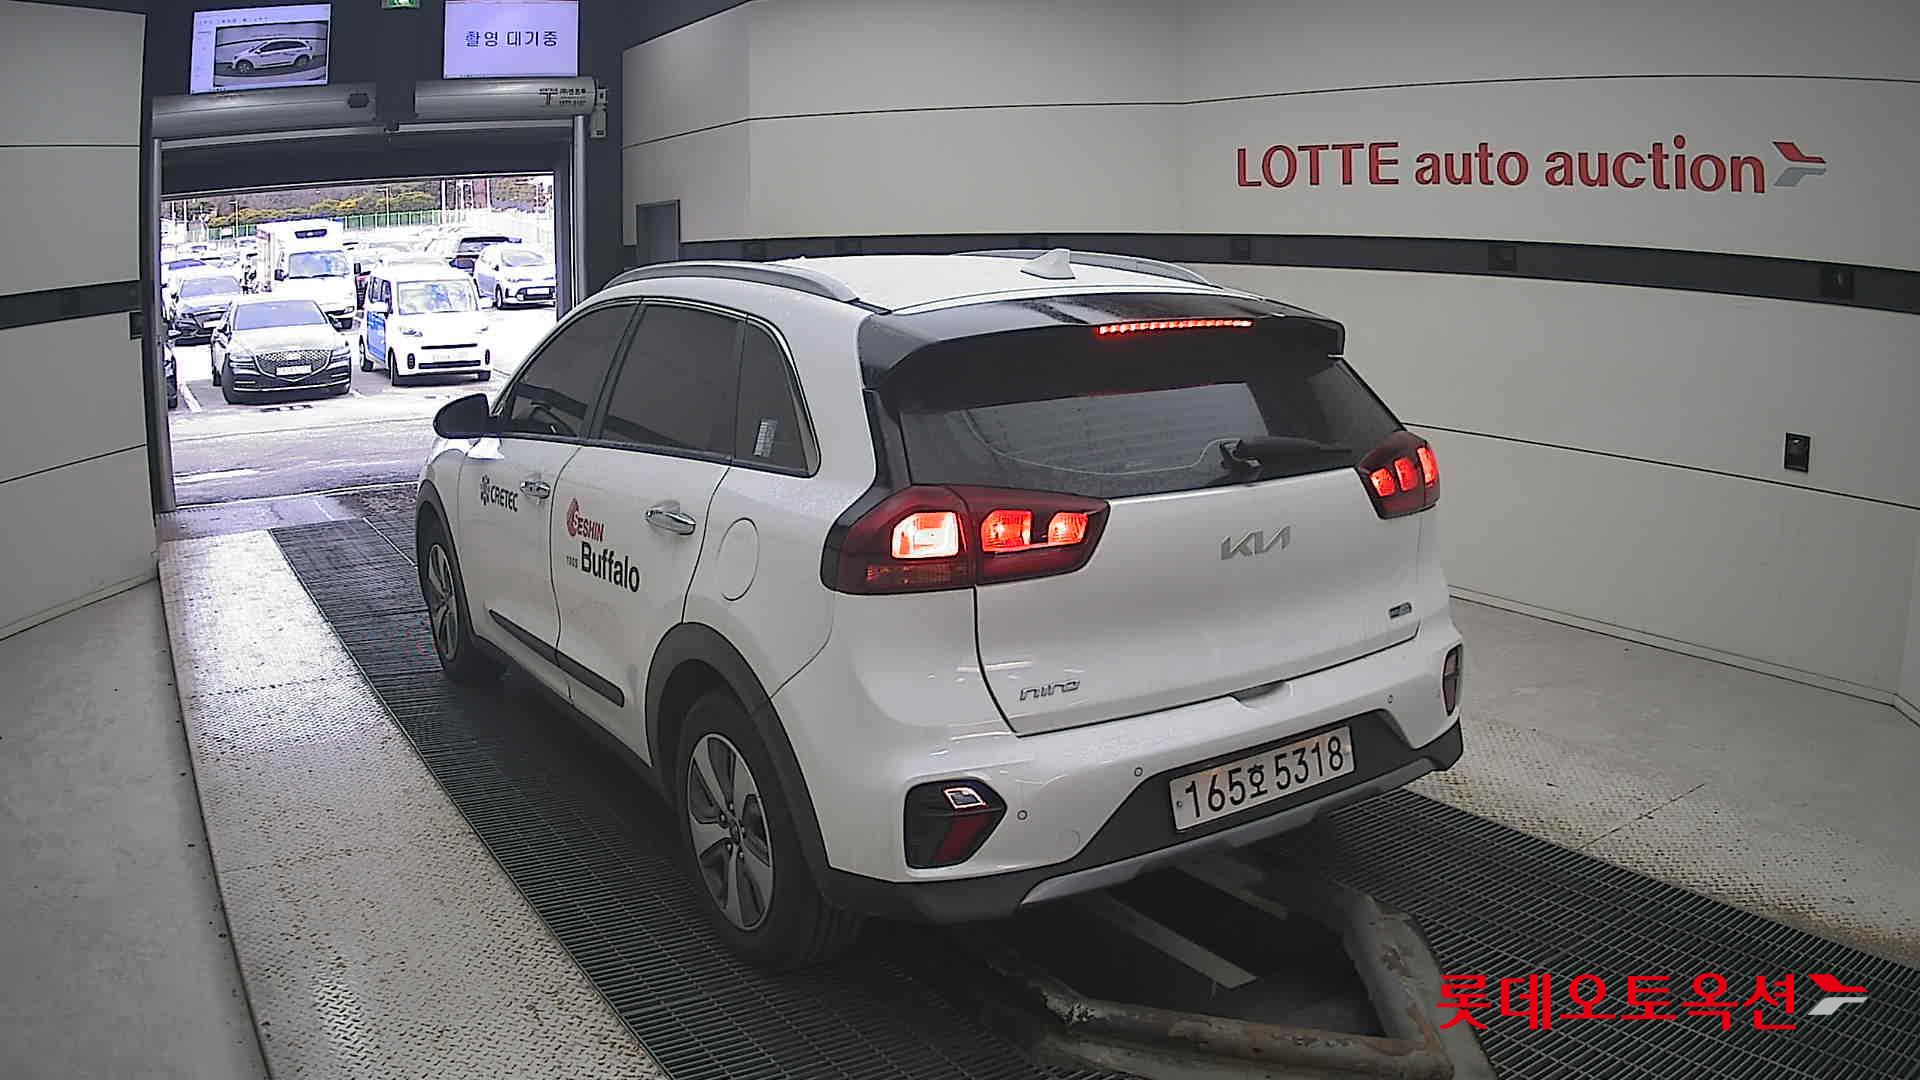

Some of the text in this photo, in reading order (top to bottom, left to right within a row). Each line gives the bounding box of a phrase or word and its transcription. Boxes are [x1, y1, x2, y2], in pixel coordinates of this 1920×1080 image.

[506, 31, 558, 47] 대기중
[1237, 135, 1766, 194] LOTTE auto auction
[490, 485, 518, 513] CRETEC
[1221, 526, 1291, 560] KIA
[581, 540, 640, 593] Buffalo
